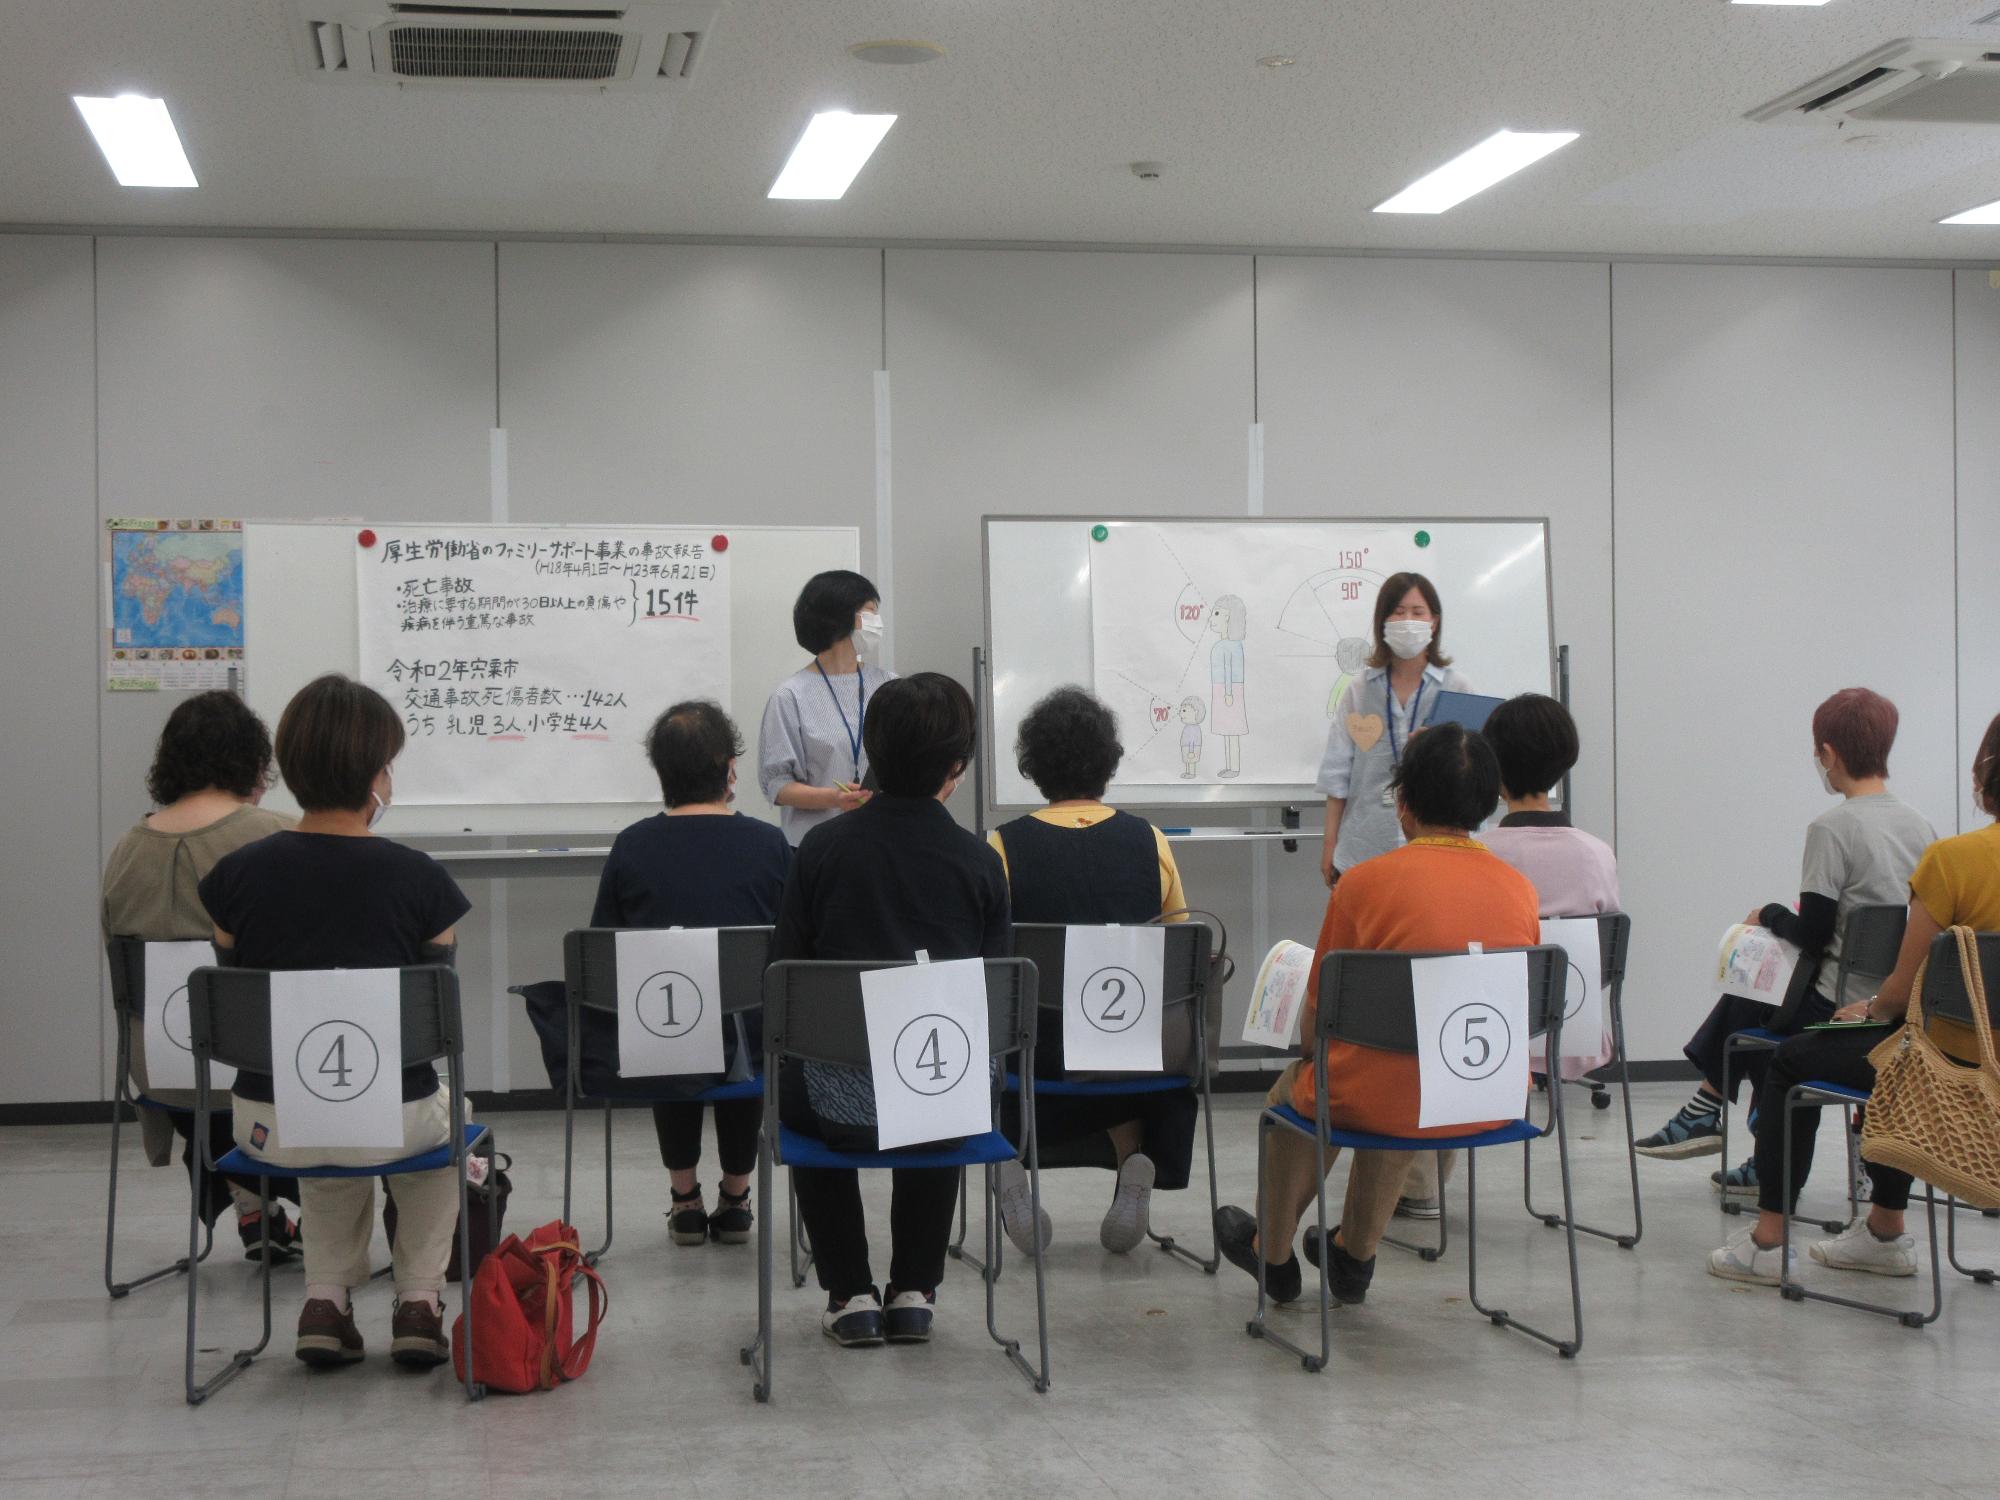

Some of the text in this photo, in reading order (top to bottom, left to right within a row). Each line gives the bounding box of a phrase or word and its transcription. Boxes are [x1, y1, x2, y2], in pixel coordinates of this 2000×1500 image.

[645, 588, 699, 617] 15件
[386, 658, 519, 683] 令和2年宍粟市
[406, 714, 436, 736] うち
